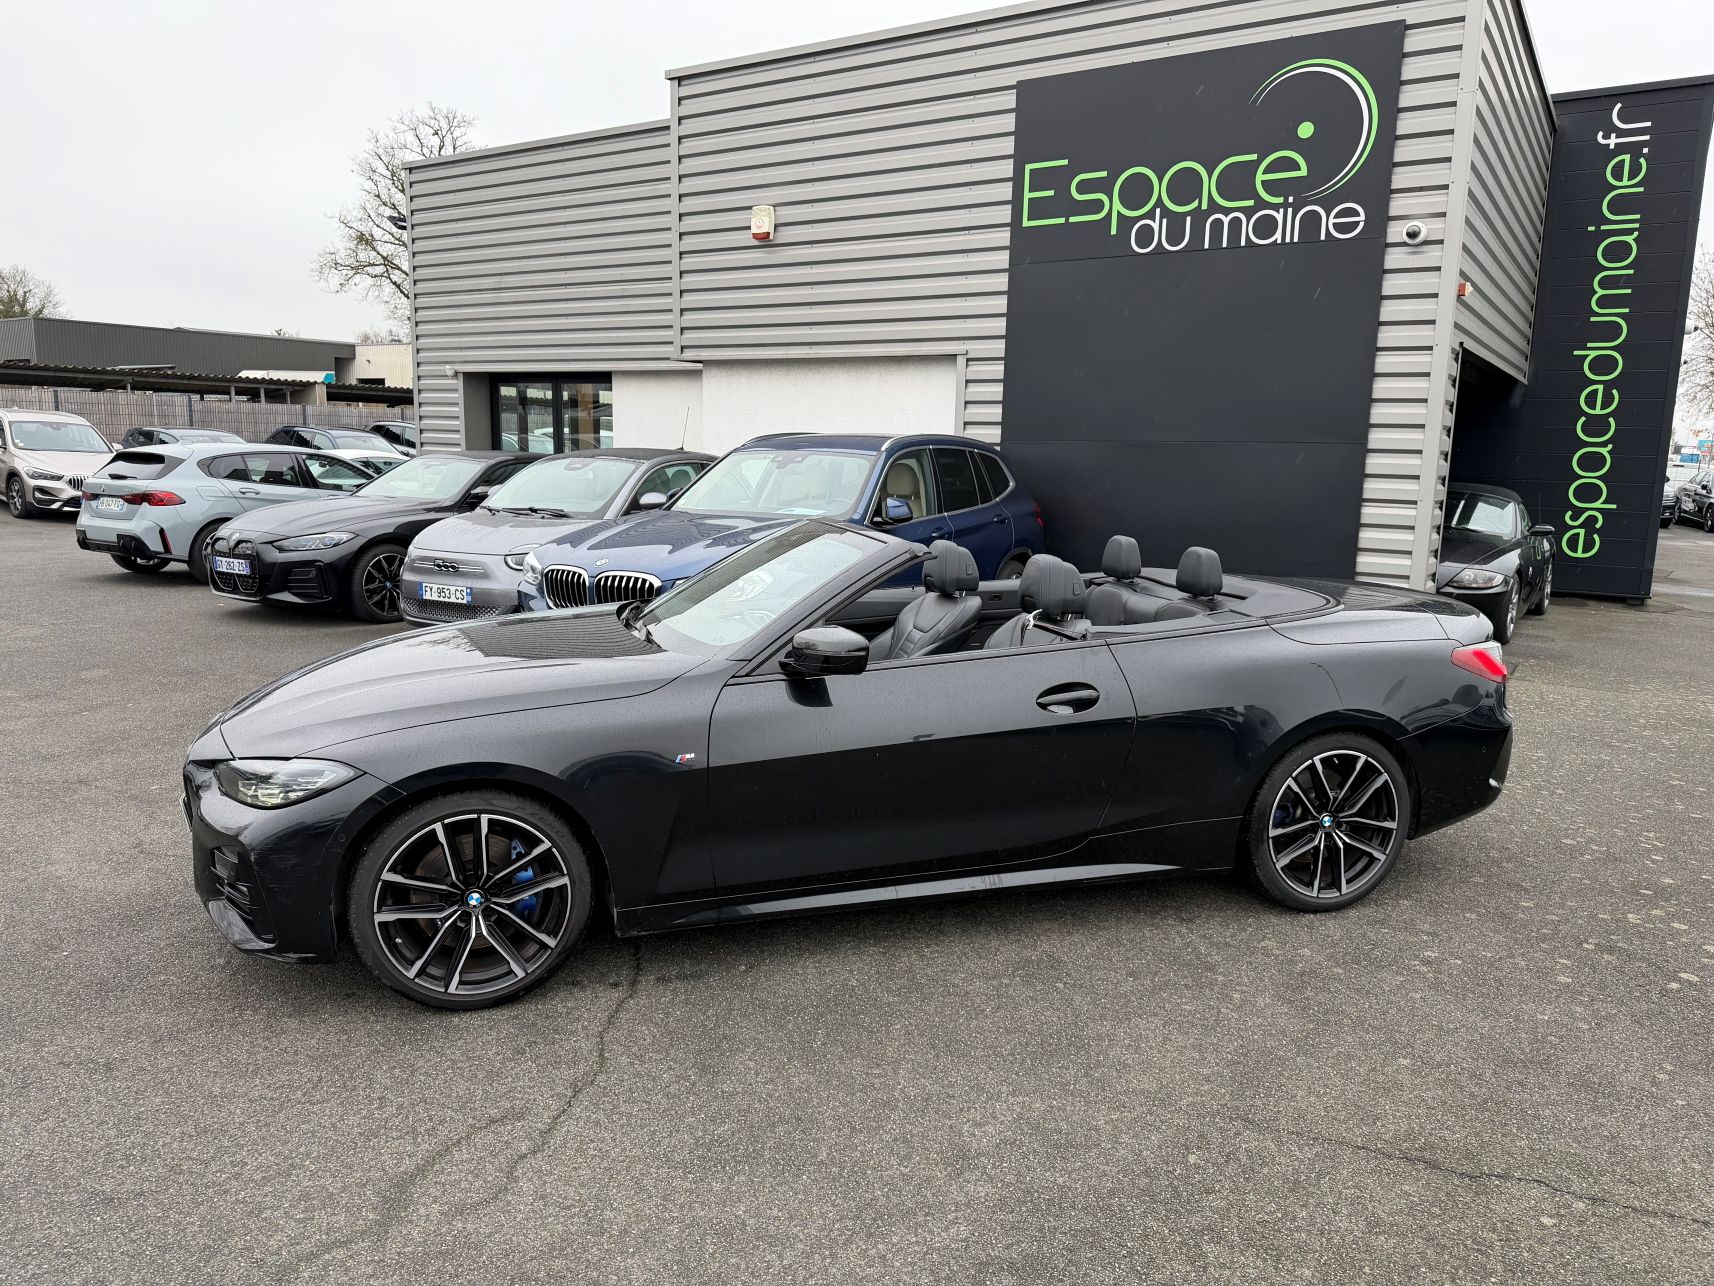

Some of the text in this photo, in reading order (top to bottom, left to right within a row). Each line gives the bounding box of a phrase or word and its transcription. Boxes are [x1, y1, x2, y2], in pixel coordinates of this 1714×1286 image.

[1022, 149, 1308, 236] Espace
[1130, 196, 1366, 254] du maine
[1561, 102, 1652, 558] espacedumaine.fr
[424, 585, 465, 601] FY-953-CS
[434, 559, 459, 572] 500
